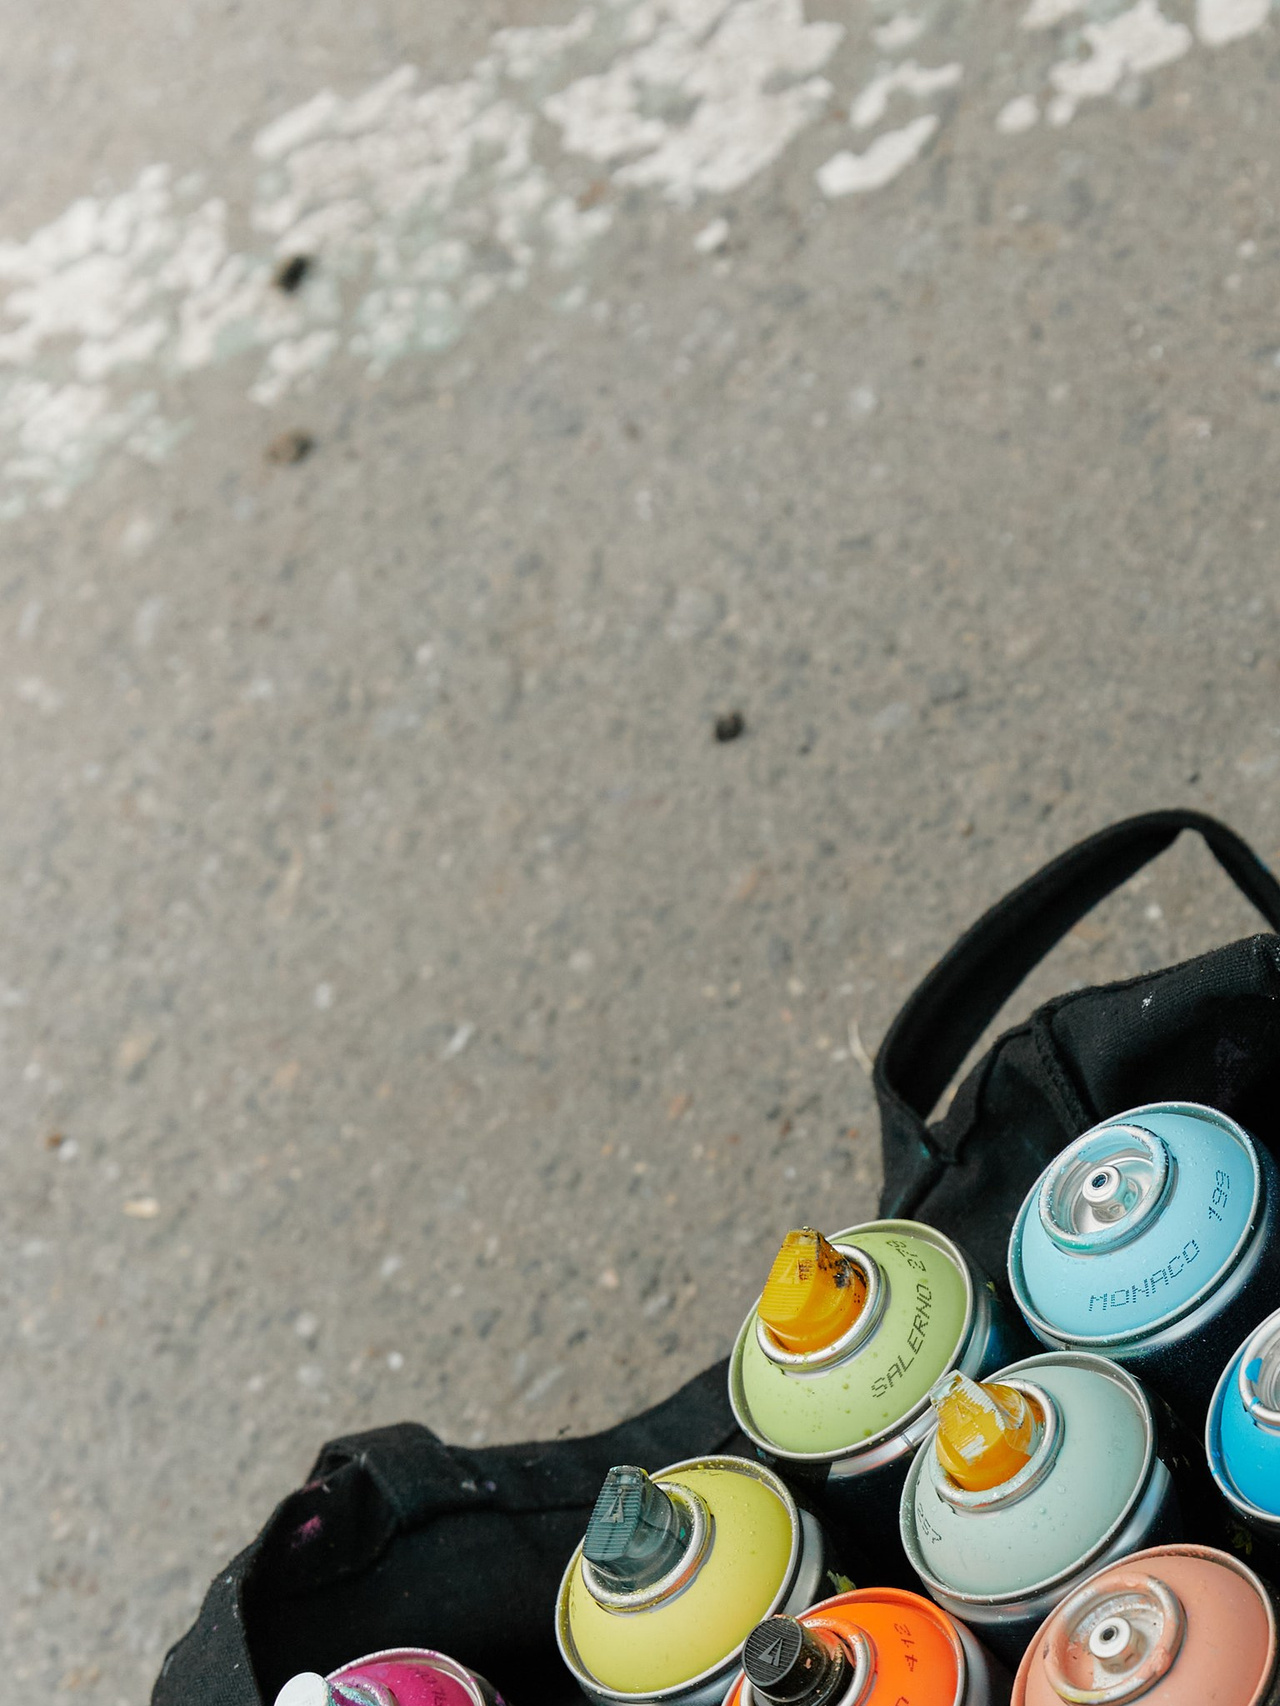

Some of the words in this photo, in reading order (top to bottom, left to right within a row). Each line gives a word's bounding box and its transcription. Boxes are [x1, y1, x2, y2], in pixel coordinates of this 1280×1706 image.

[1089, 1239, 1201, 1313] MONACO
[1207, 1169, 1231, 1222] 199
[870, 1282, 933, 1399] SALERNO
[893, 1622, 919, 1673] 412
